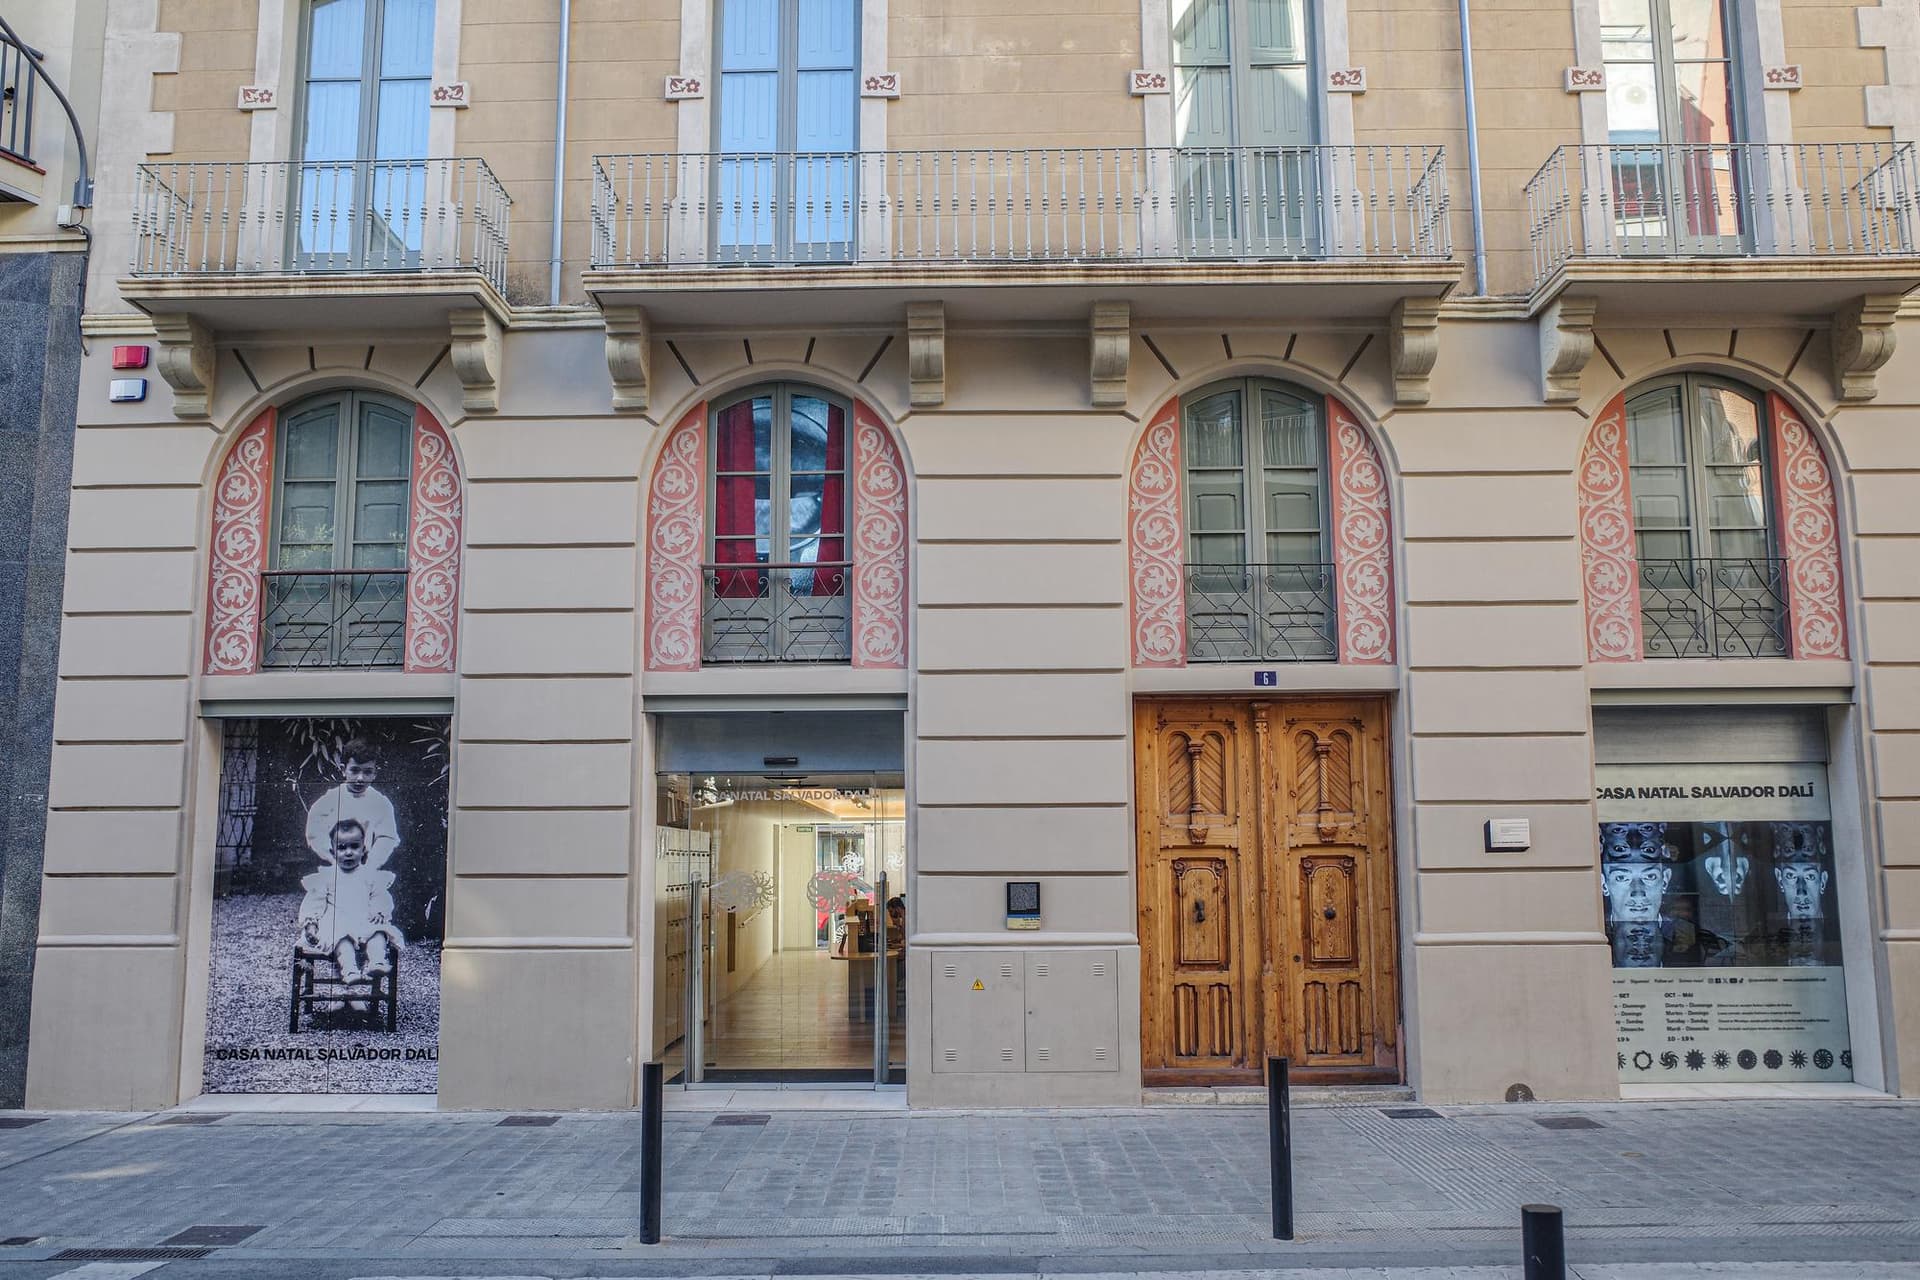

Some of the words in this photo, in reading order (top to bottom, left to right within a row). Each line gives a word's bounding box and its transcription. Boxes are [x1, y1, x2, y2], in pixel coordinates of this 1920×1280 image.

[1263, 672, 1269, 685] 6
[730, 790, 770, 801] NATAL
[773, 788, 840, 801] SALVADOR
[1638, 786, 1689, 799] NATAL
[1691, 785, 1775, 799] SALVADOR
[1778, 781, 1814, 797] DALÍ
[216, 1049, 261, 1061] CASA
[264, 1049, 313, 1061] NATAL
[317, 1049, 401, 1061] SALVADOR
